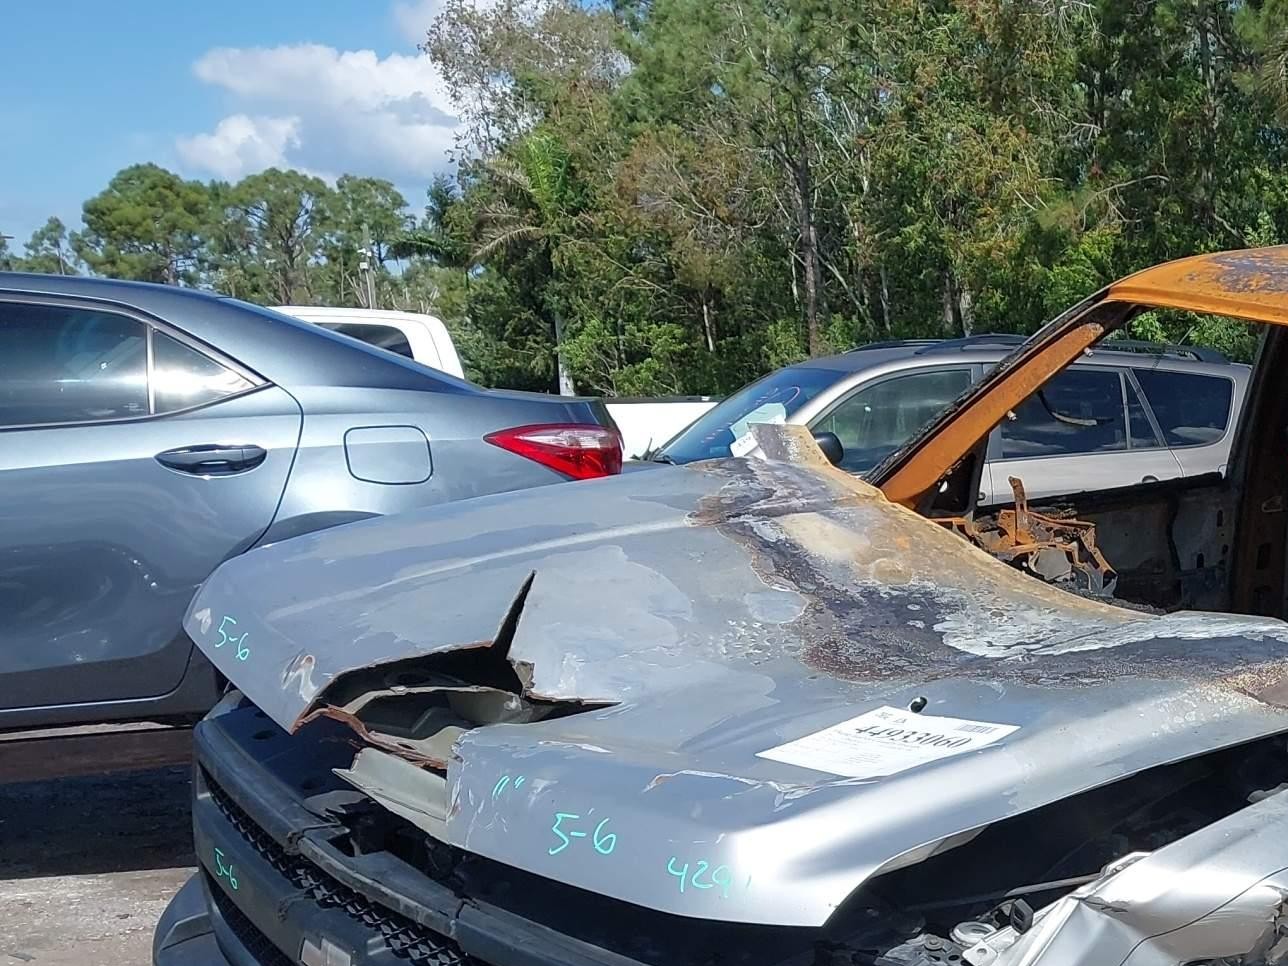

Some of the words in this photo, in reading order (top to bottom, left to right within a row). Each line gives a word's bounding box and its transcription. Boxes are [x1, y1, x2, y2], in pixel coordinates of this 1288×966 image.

[214, 615, 250, 661] 5-6
[855, 724, 973, 749] 44933060
[548, 811, 617, 855] 5-6
